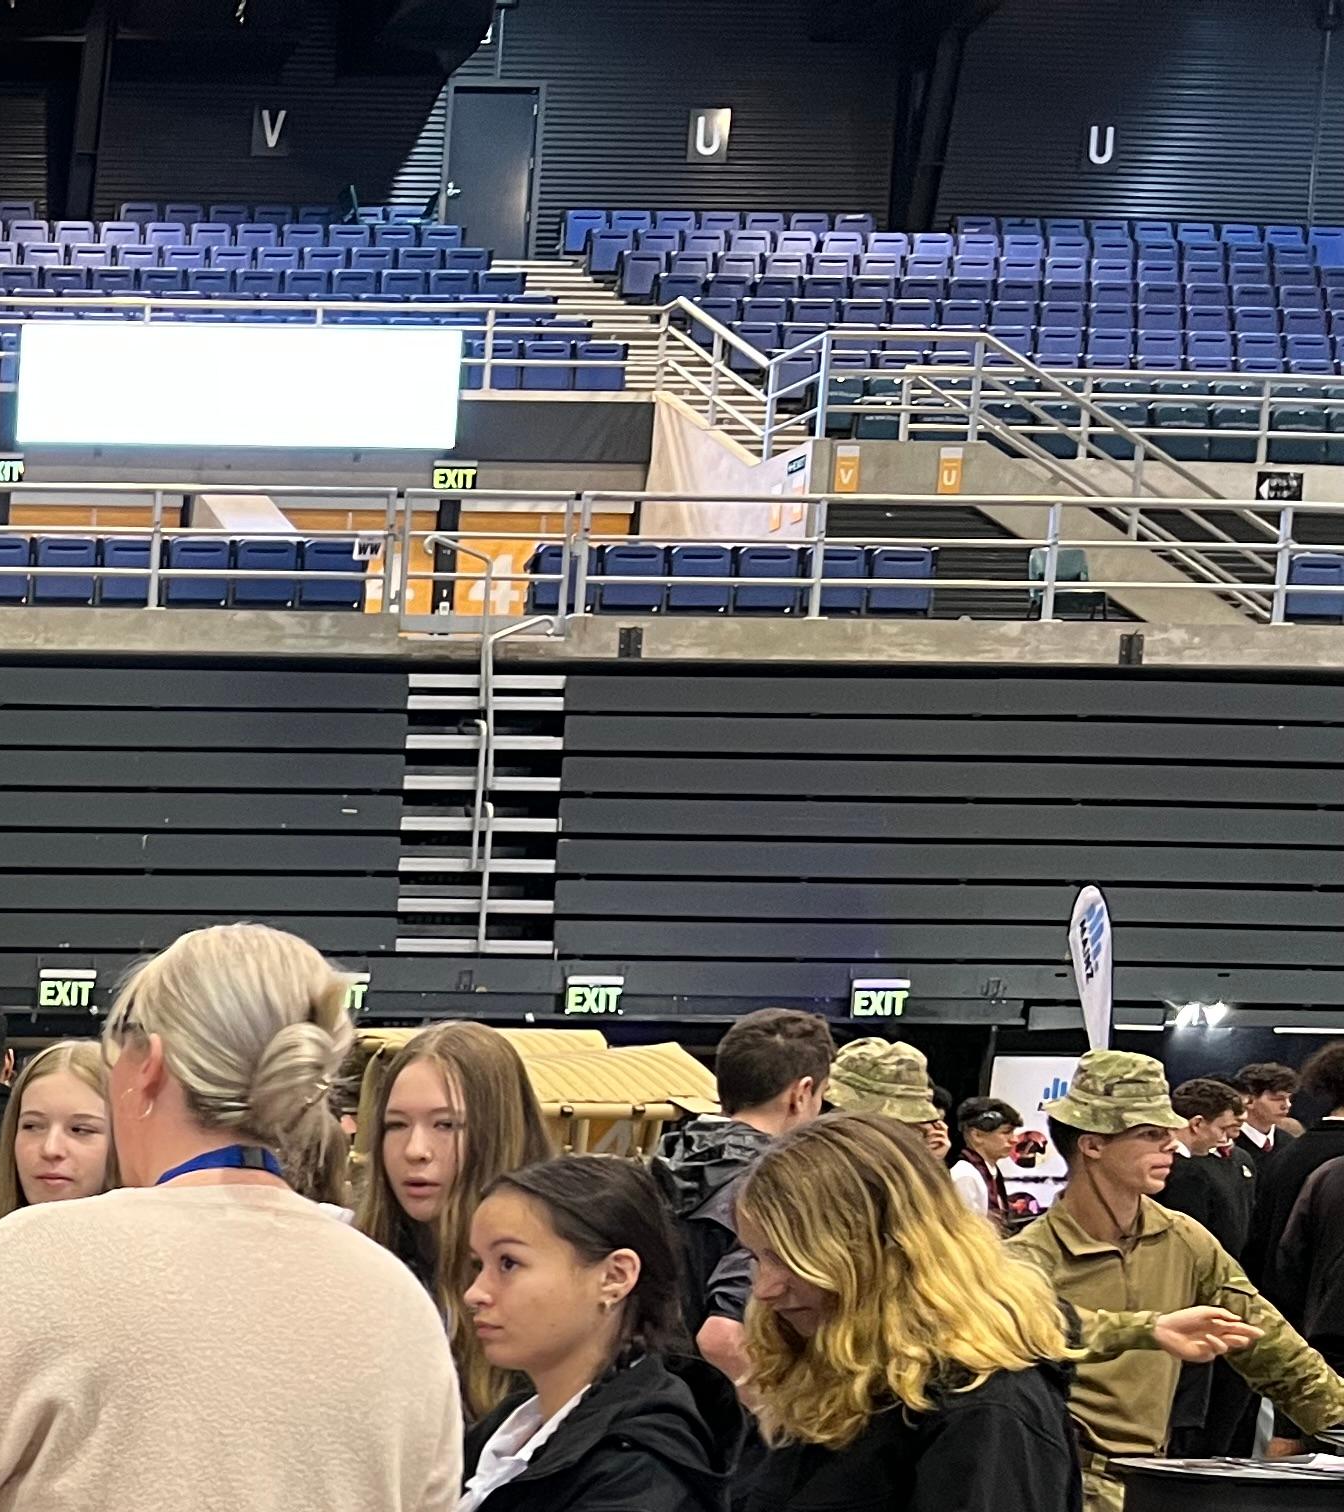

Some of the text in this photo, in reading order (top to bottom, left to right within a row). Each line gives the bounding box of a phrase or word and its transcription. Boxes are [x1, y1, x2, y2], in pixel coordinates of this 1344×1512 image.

[262, 109, 287, 148] V
[696, 116, 725, 156] U
[1089, 126, 1115, 165] U
[433, 468, 477, 489] EXIT
[839, 468, 854, 485] V
[943, 470, 957, 486] U
[358, 543, 381, 556] WW
[468, 554, 520, 615] 4
[39, 979, 95, 1007] EXIT
[567, 986, 623, 1013] EXIT
[853, 990, 909, 1017] EXIT
